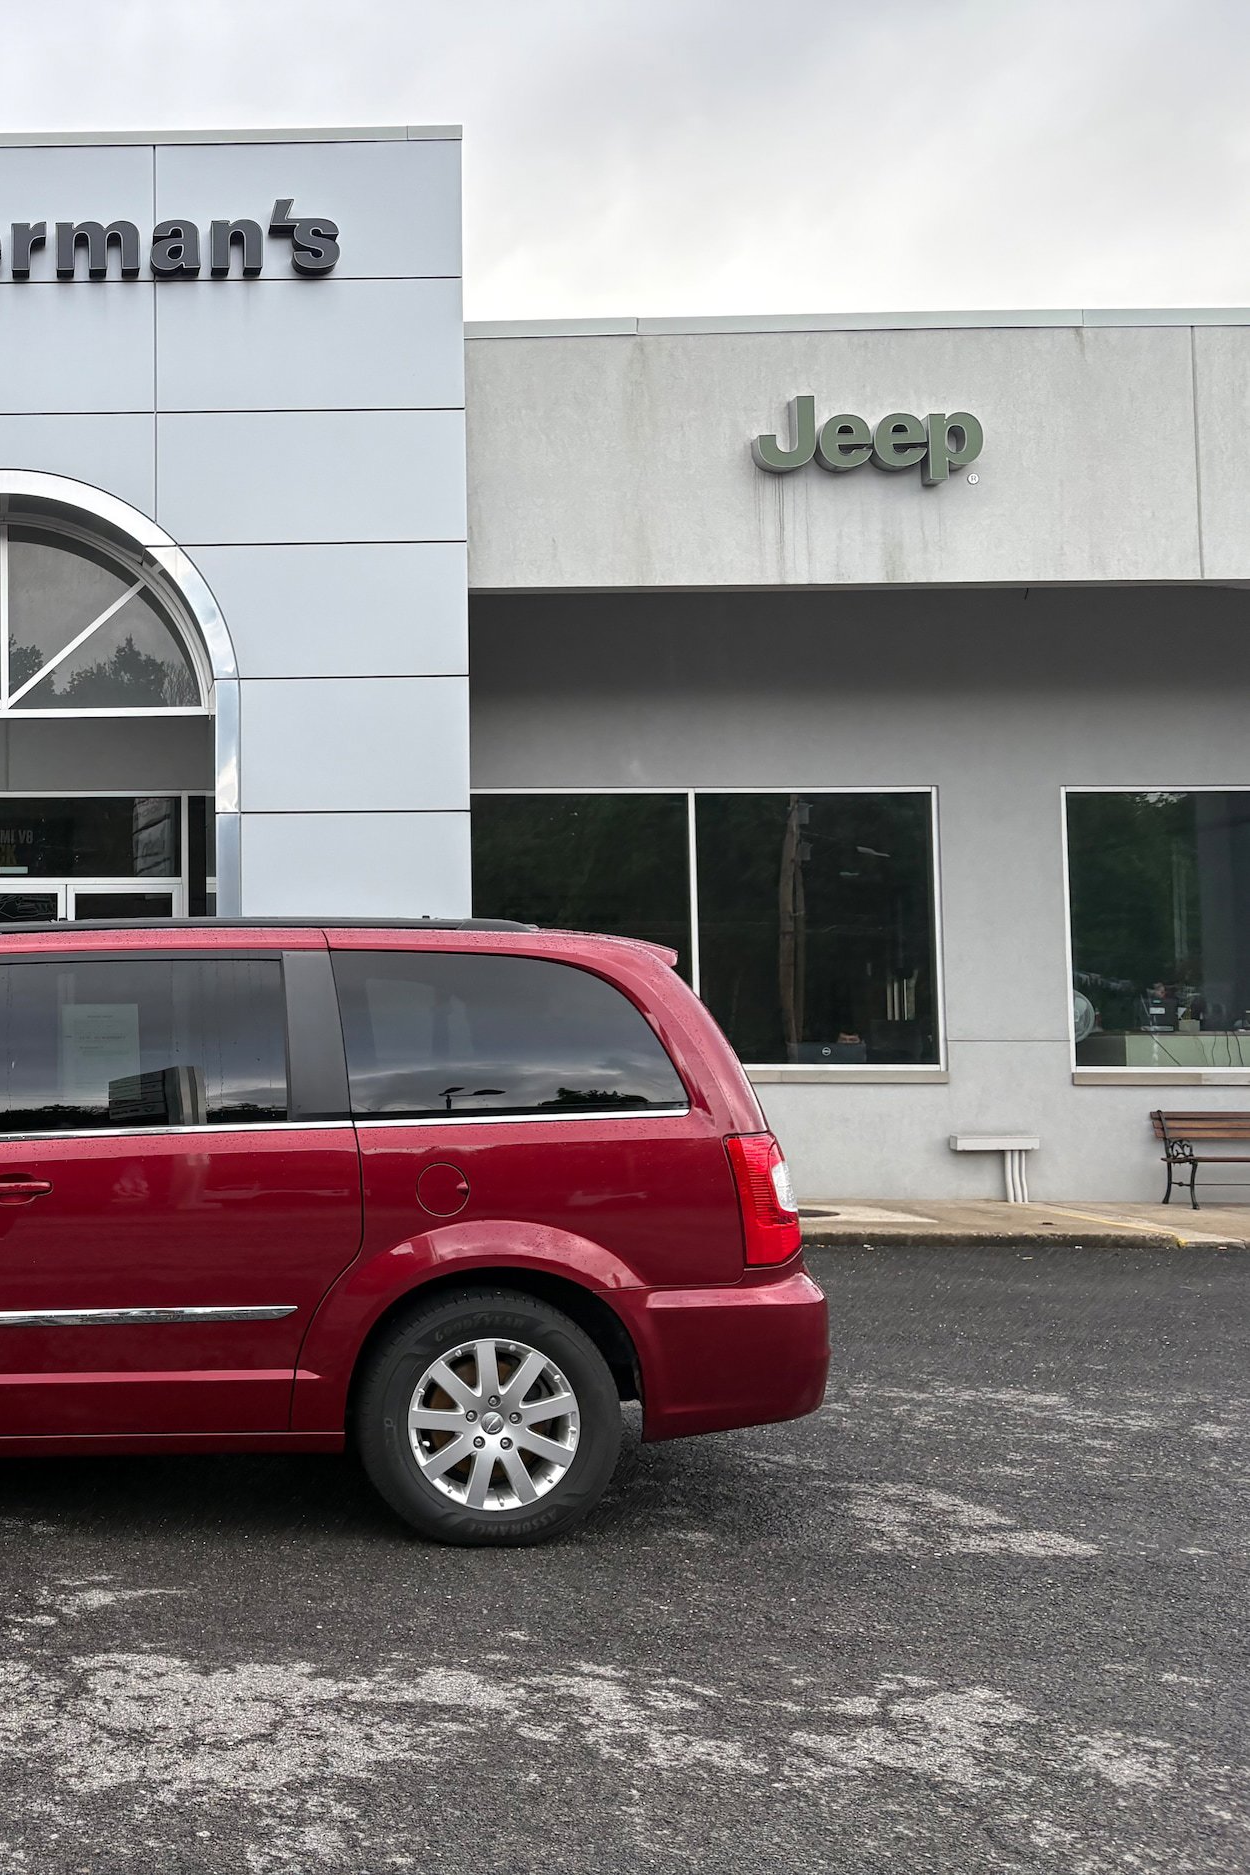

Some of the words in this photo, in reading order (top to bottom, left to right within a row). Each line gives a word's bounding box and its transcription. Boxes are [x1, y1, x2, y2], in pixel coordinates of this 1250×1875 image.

[751, 395, 984, 487] Jeep
[18, 829, 34, 845] V8
[434, 1312, 526, 1342] GOODYEAR
